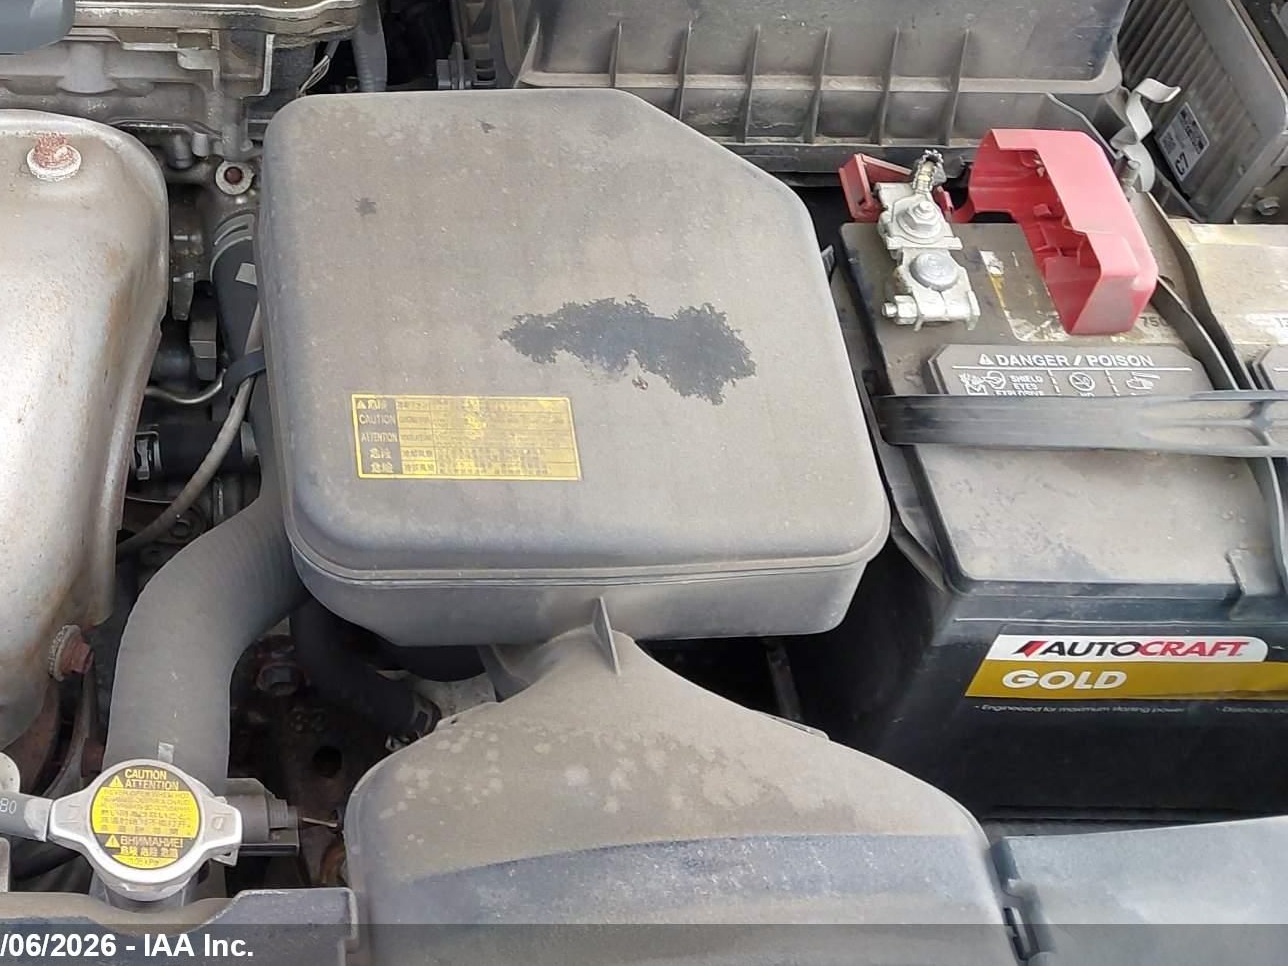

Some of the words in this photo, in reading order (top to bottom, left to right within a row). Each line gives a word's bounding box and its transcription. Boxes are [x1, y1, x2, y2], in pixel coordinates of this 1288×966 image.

[996, 354, 1071, 367] DANGER
[1086, 354, 1155, 367] POISON
[1011, 375, 1044, 384] SHIELD
[1013, 383, 1039, 391] EYES
[359, 414, 396, 425] CAUTION
[361, 432, 398, 443] ATTENTION
[1042, 641, 1250, 657] AUTOCRAFT
[1002, 669, 1127, 690] GOLD
[125, 769, 167, 780] CAUTION
[125, 780, 179, 791] ATTENTION
[0, 797, 17, 814] 08
